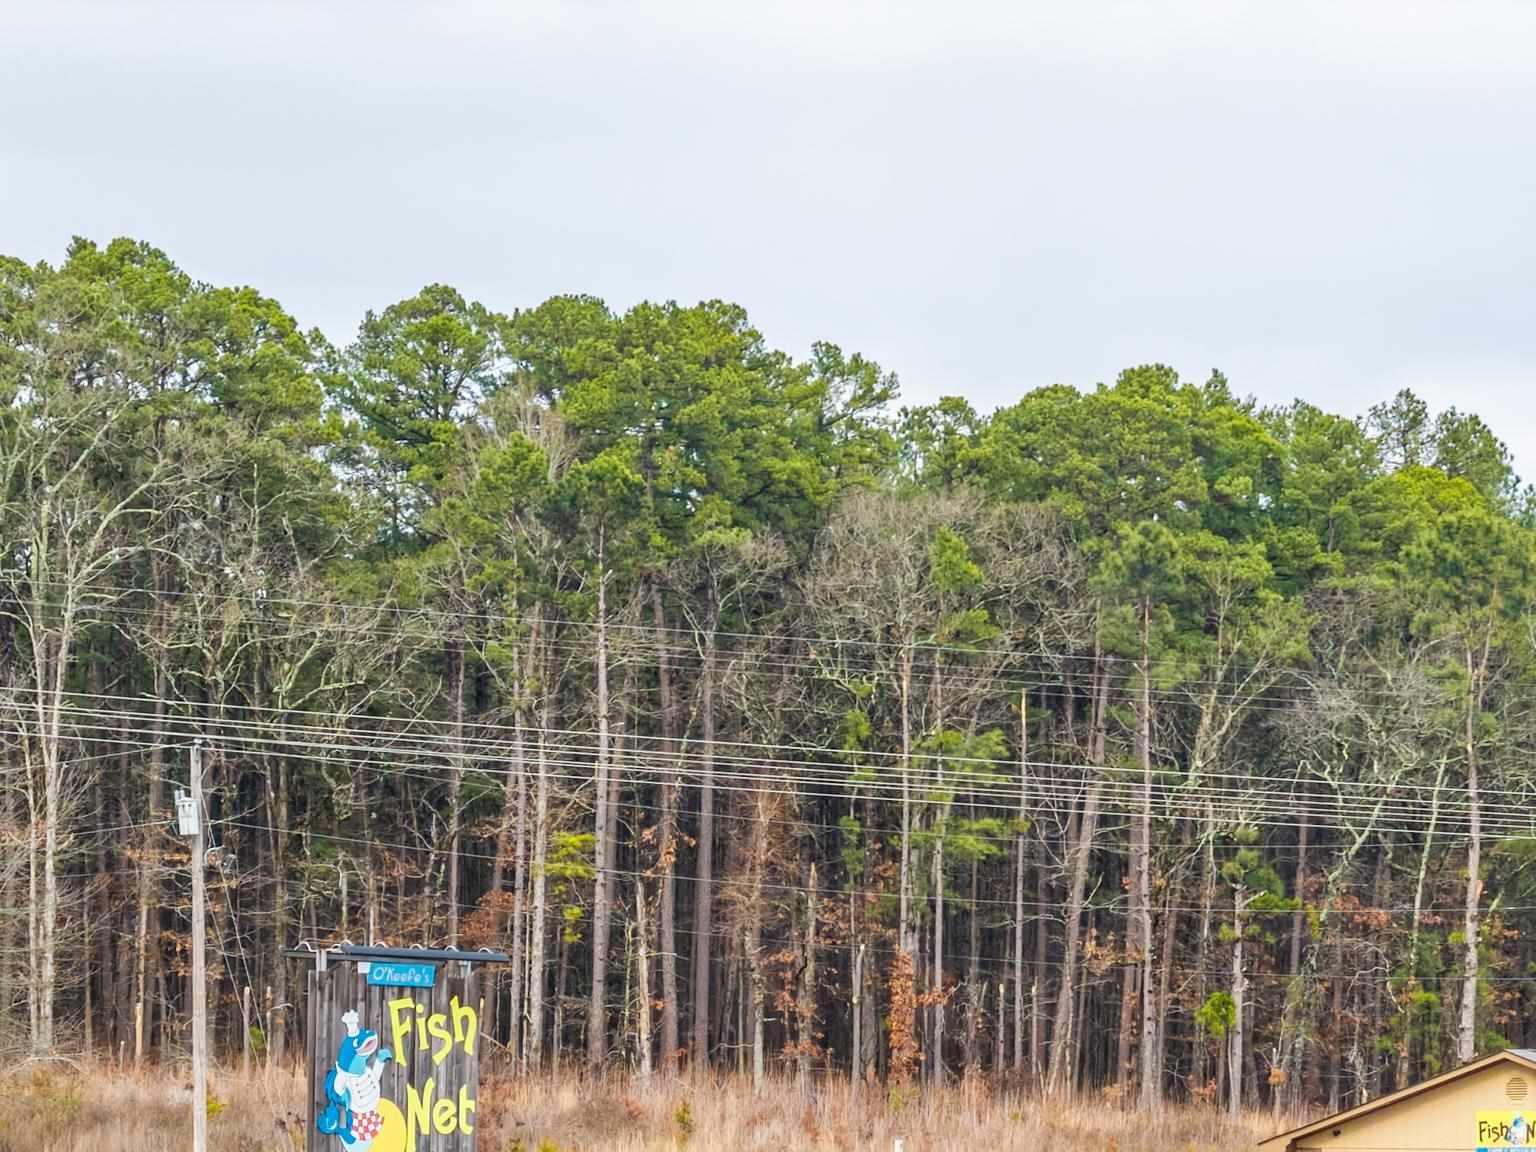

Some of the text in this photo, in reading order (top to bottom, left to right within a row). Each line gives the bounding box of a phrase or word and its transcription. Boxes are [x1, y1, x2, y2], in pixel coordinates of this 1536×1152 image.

[373, 966, 430, 984] O'Keefe's
[388, 995, 478, 1067] Fish
[1478, 1121, 1509, 1143] Fish
